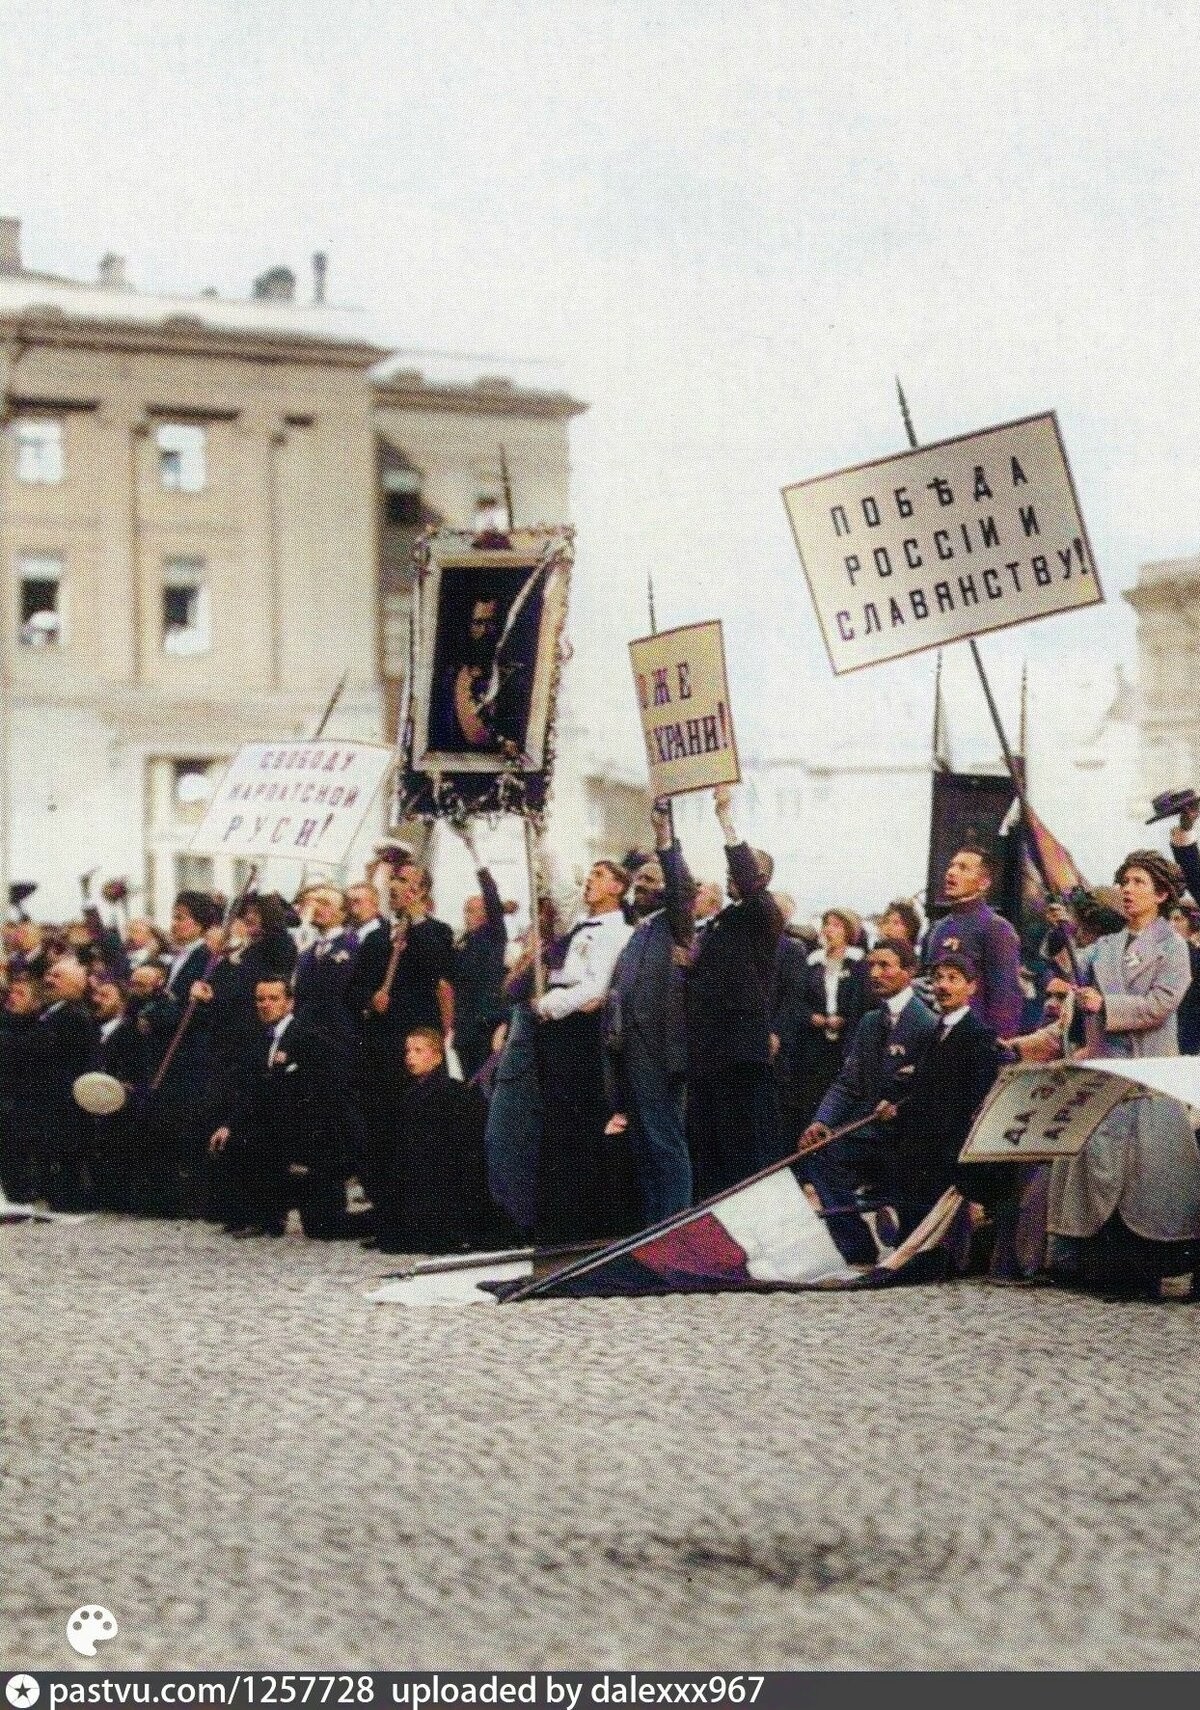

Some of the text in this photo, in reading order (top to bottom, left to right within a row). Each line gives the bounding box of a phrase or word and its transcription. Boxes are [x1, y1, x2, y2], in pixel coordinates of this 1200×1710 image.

[845, 505, 1041, 587] РОССІИ И
[836, 537, 1090, 641] СЛАВЯНСТВУ!
[259, 750, 357, 772] СВОБОДУ
[222, 812, 336, 848] РУСИ!
